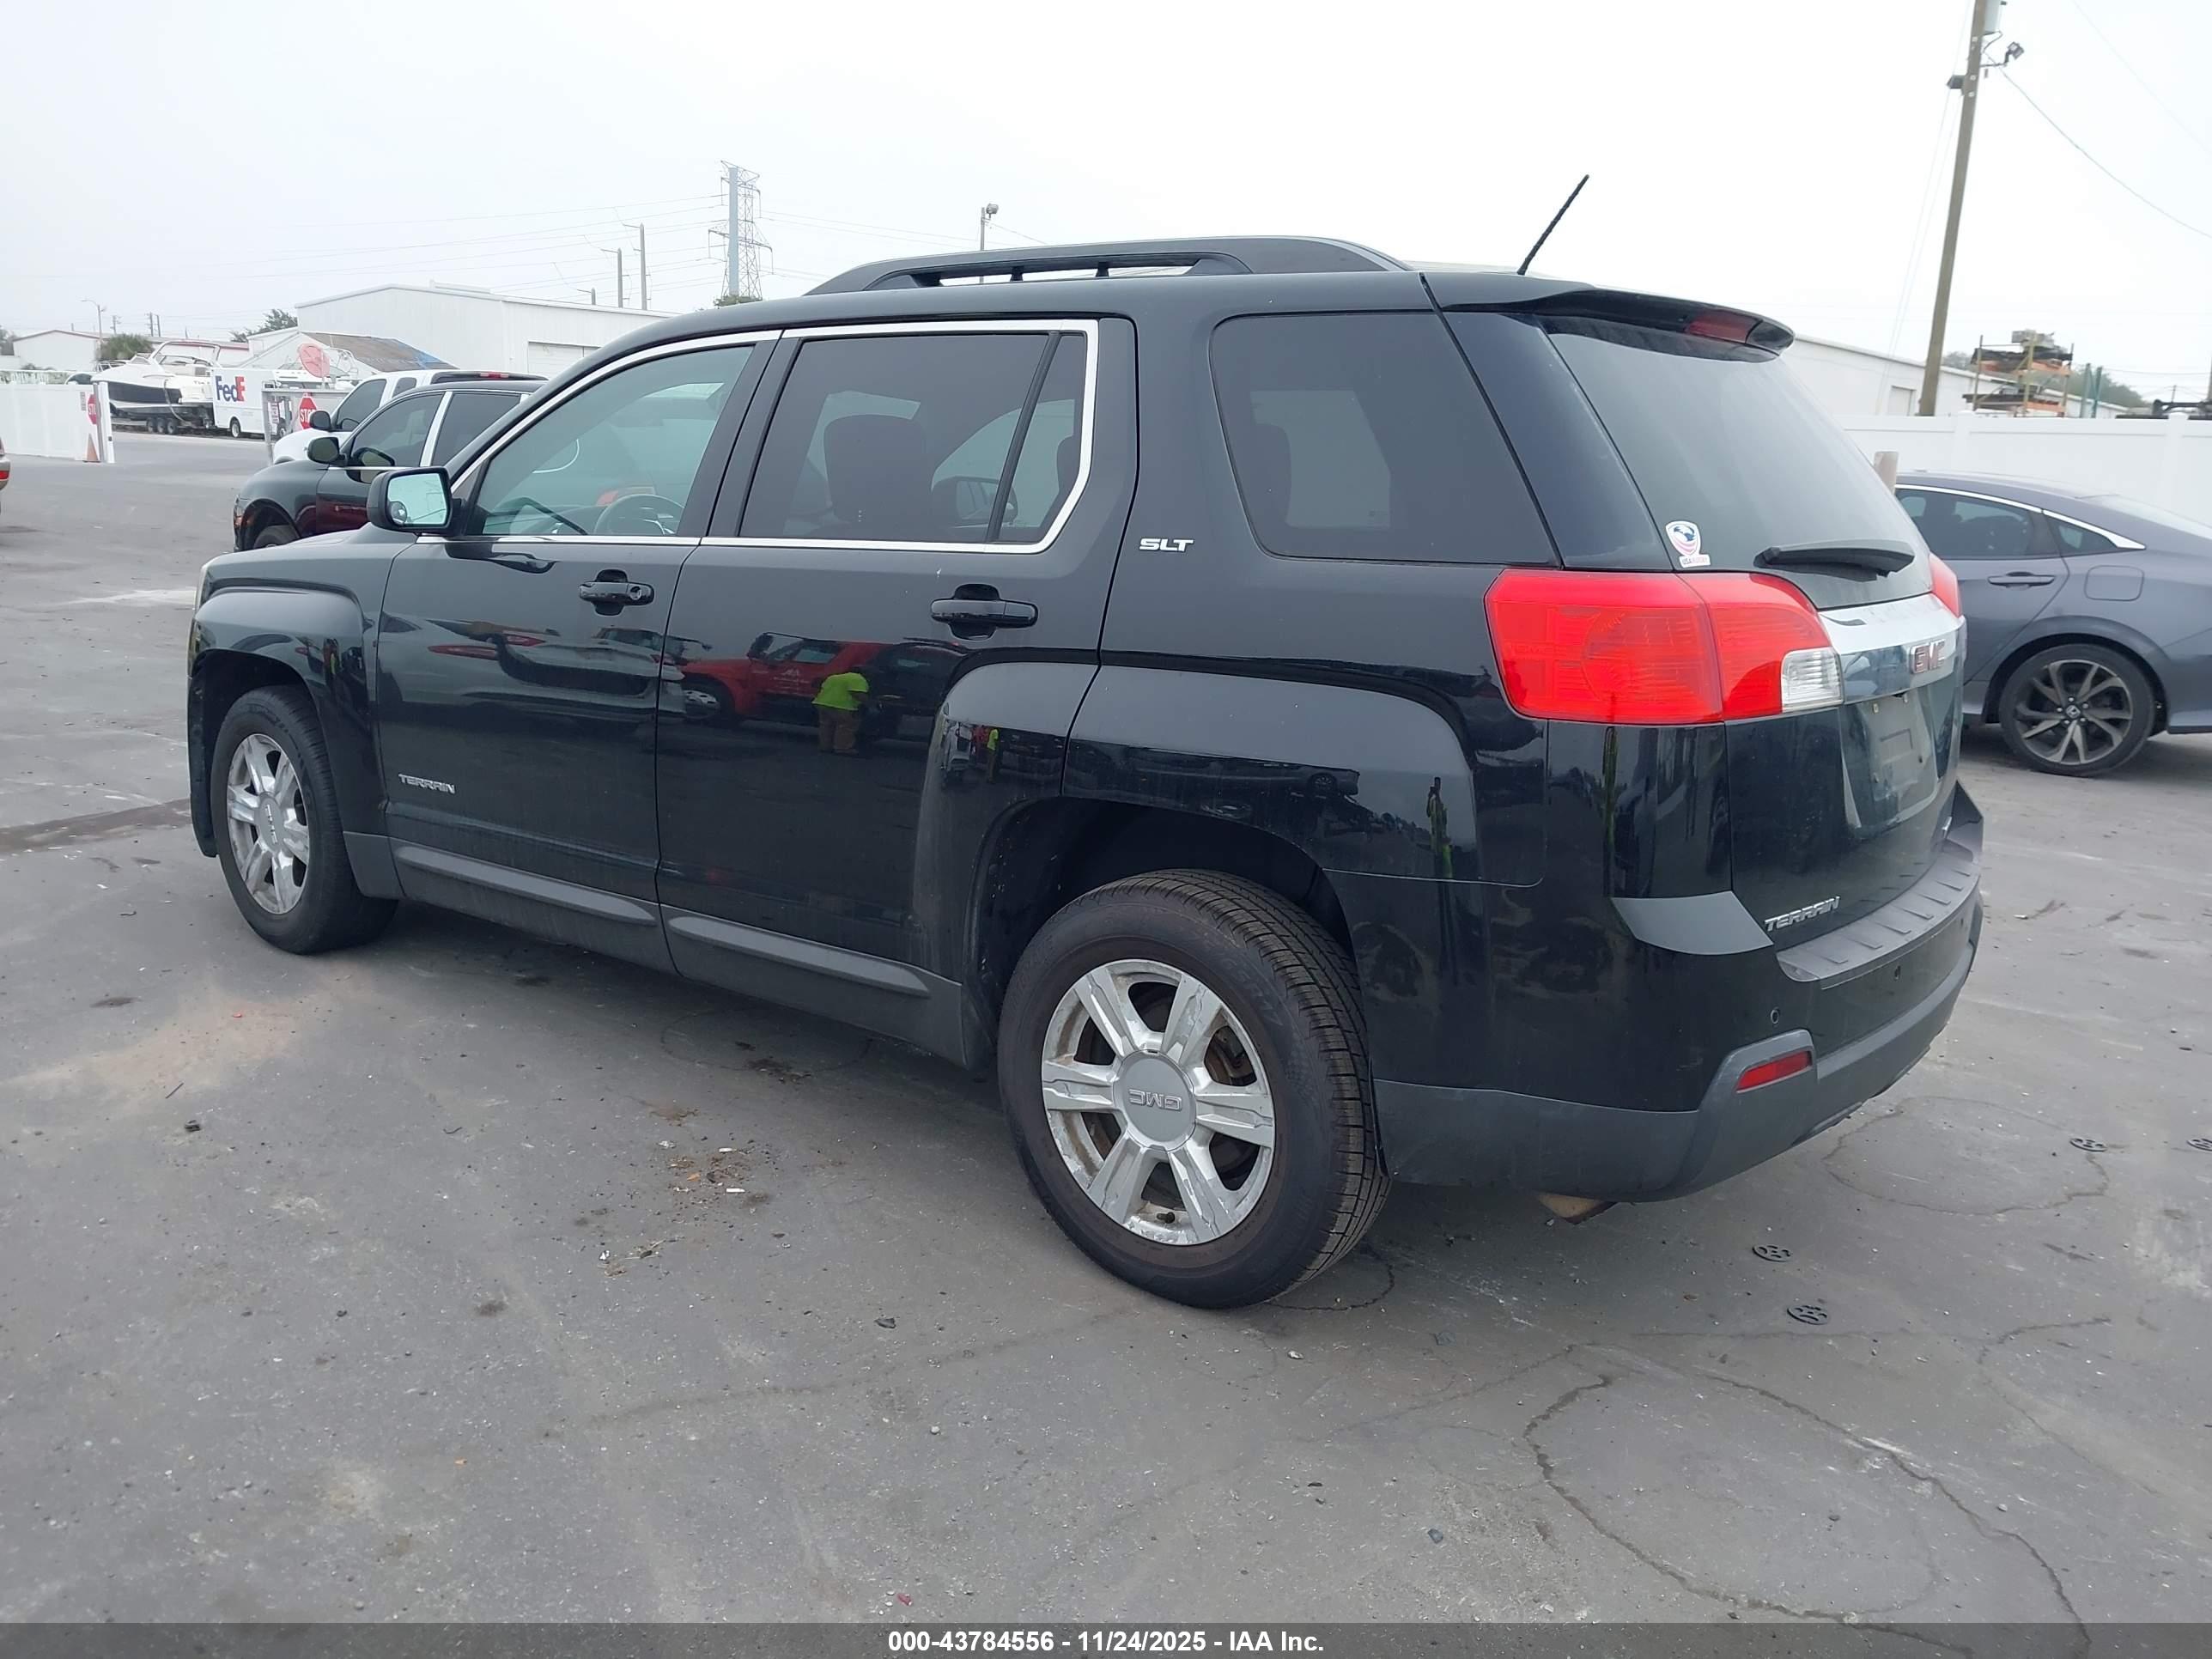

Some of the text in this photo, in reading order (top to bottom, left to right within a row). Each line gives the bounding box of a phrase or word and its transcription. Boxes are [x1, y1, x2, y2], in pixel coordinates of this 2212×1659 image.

[1139, 538, 1194, 552] SLT
[398, 773, 456, 794] TERRAIN
[1764, 896, 1840, 932] TERRAIN
[1128, 1088, 1182, 1111] GMC
